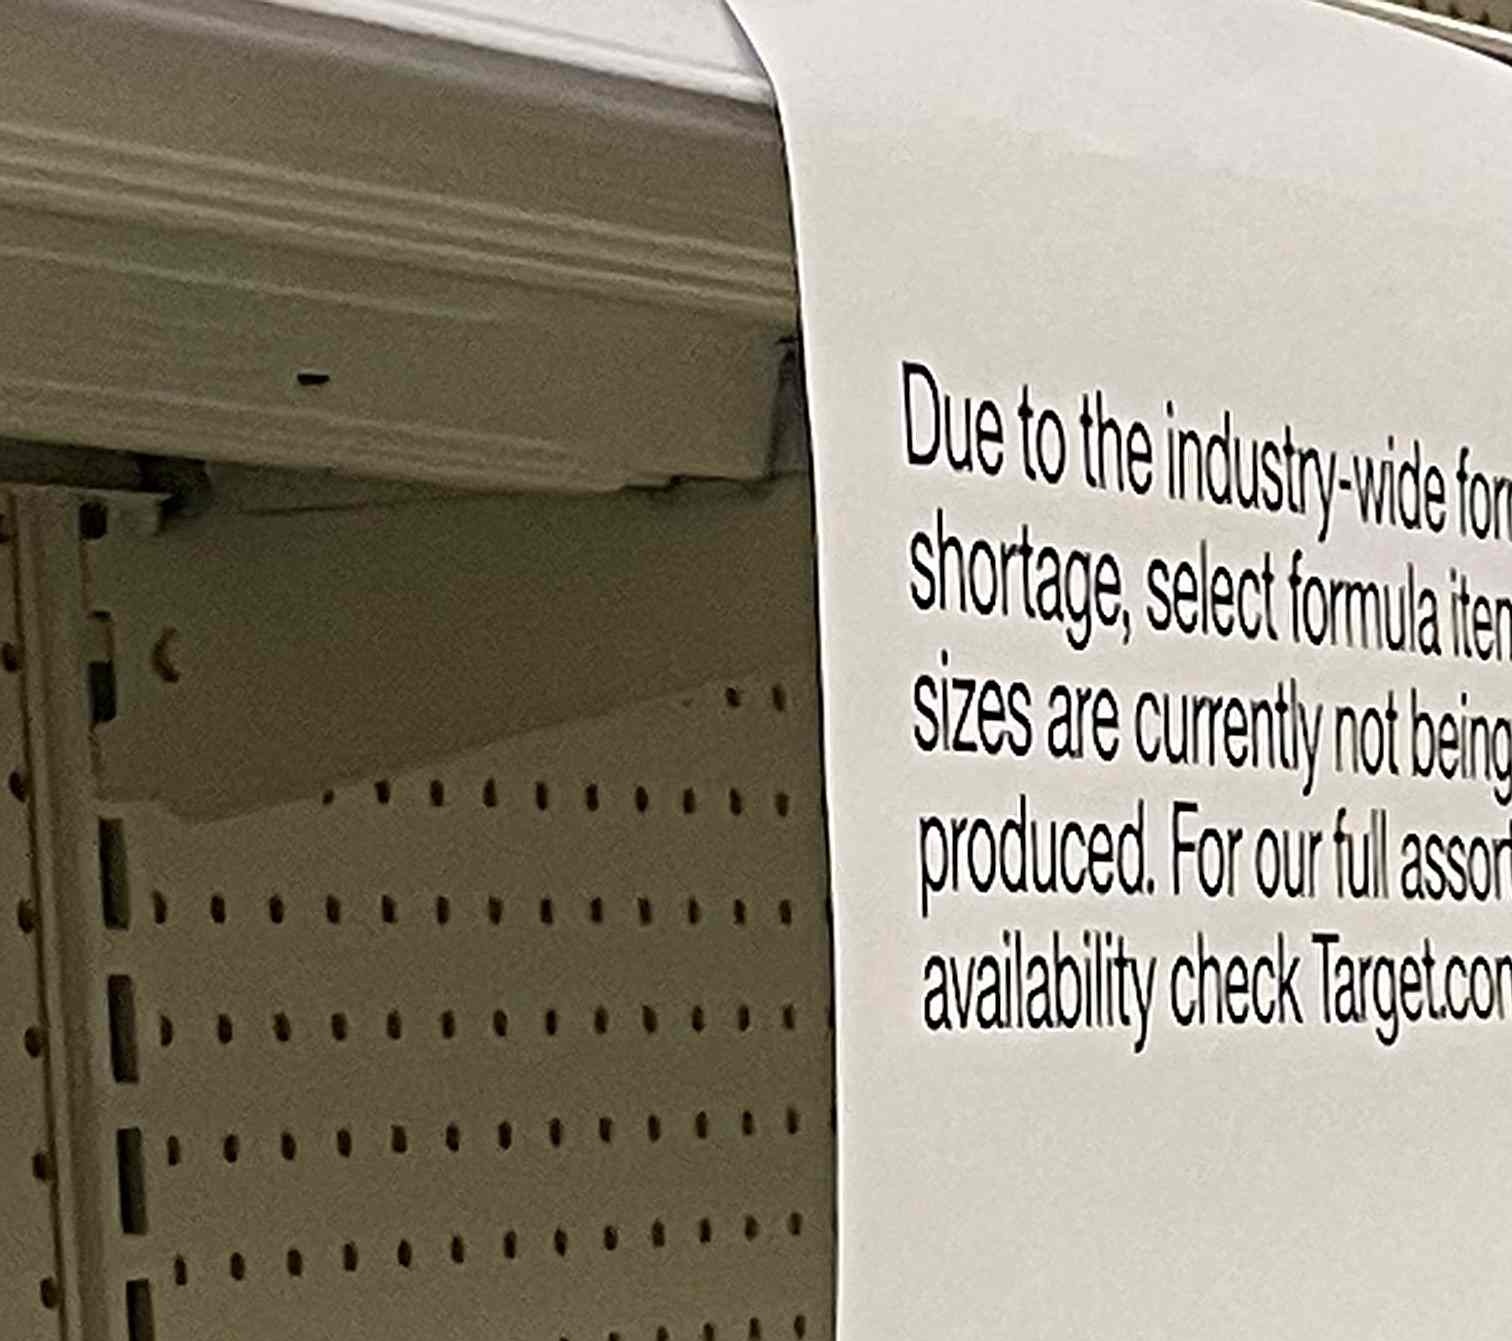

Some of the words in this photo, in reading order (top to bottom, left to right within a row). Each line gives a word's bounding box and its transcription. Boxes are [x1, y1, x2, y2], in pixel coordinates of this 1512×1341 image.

[902, 360, 1003, 476] Due
[1018, 383, 1066, 484] to
[1079, 389, 1152, 494] the
[1166, 400, 1446, 543] industry-wide
[911, 507, 1131, 650] shortage,
[1147, 539, 1278, 641] select
[1289, 549, 1441, 656] formula
[914, 649, 1031, 756] sizes
[1049, 685, 1119, 761] are
[1135, 678, 1323, 796] currently
[1336, 690, 1399, 775] not
[1411, 688, 1512, 806] being
[919, 793, 1155, 918] produced.
[1173, 801, 1243, 897] For
[1255, 827, 1322, 898] our
[1333, 807, 1388, 898] full
[923, 930, 1156, 1053] availability
[1171, 931, 1303, 1025] check
